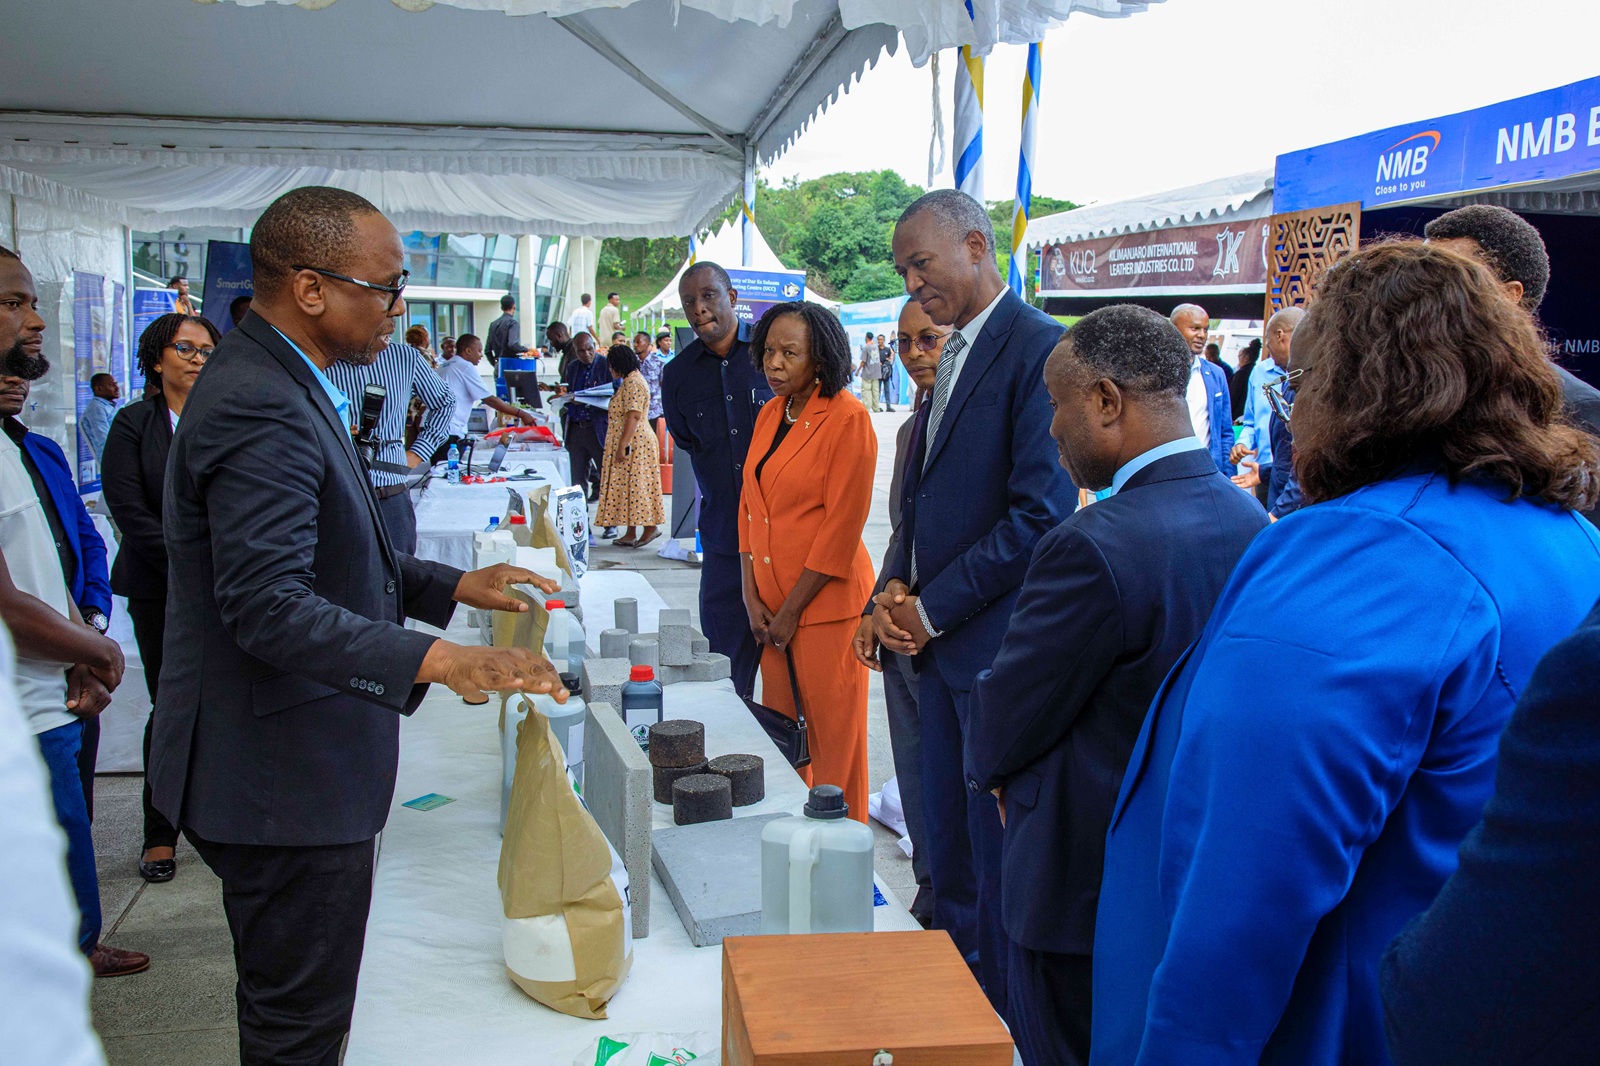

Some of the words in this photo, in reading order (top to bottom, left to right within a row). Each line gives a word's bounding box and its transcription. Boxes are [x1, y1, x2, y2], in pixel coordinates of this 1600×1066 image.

[1496, 113, 1576, 165] NMB
[1376, 145, 1428, 183] NMB
[1375, 184, 1397, 196] Close
[1399, 183, 1408, 192] to
[1410, 180, 1426, 192] you
[1109, 245, 1147, 262] KILIMANJARO
[1147, 241, 1198, 258] INTERNATIONAL
[1109, 261, 1134, 277] LEATHER
[1134, 258, 1167, 275] INDUSTRIES
[1167, 258, 1180, 273] CO.
[1180, 257, 1195, 272] LTD
[1565, 338, 1600, 353] NMB
